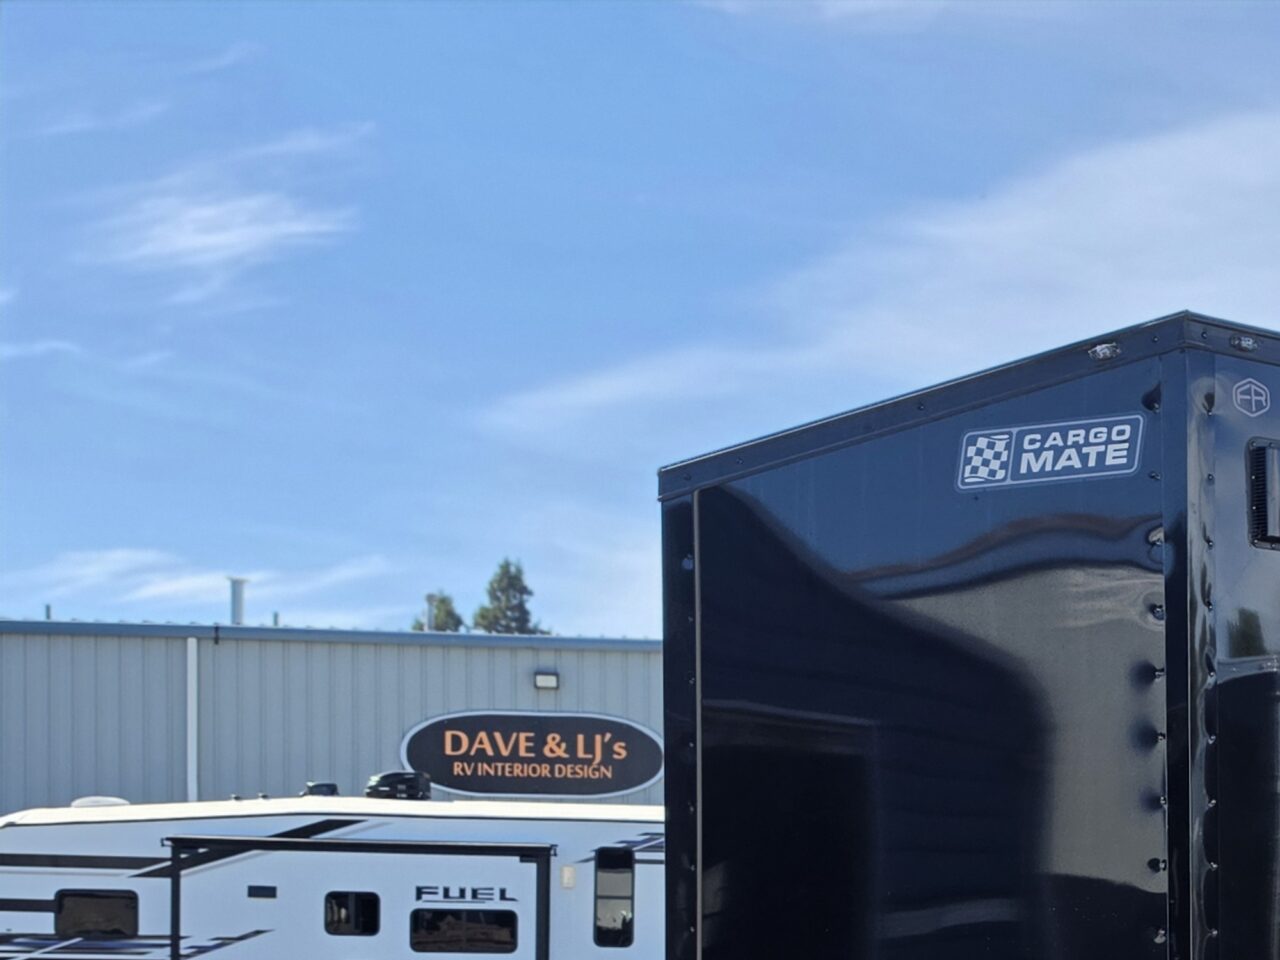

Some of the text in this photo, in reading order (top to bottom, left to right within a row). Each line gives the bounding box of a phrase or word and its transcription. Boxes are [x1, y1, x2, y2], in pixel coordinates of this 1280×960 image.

[1022, 424, 1132, 450] CARGO
[1019, 443, 1130, 475] MATE
[443, 730, 536, 758] DAVE
[542, 732, 570, 758] &
[453, 762, 613, 779] RV INTERIOR DESIGN
[415, 885, 519, 902] FUEL
